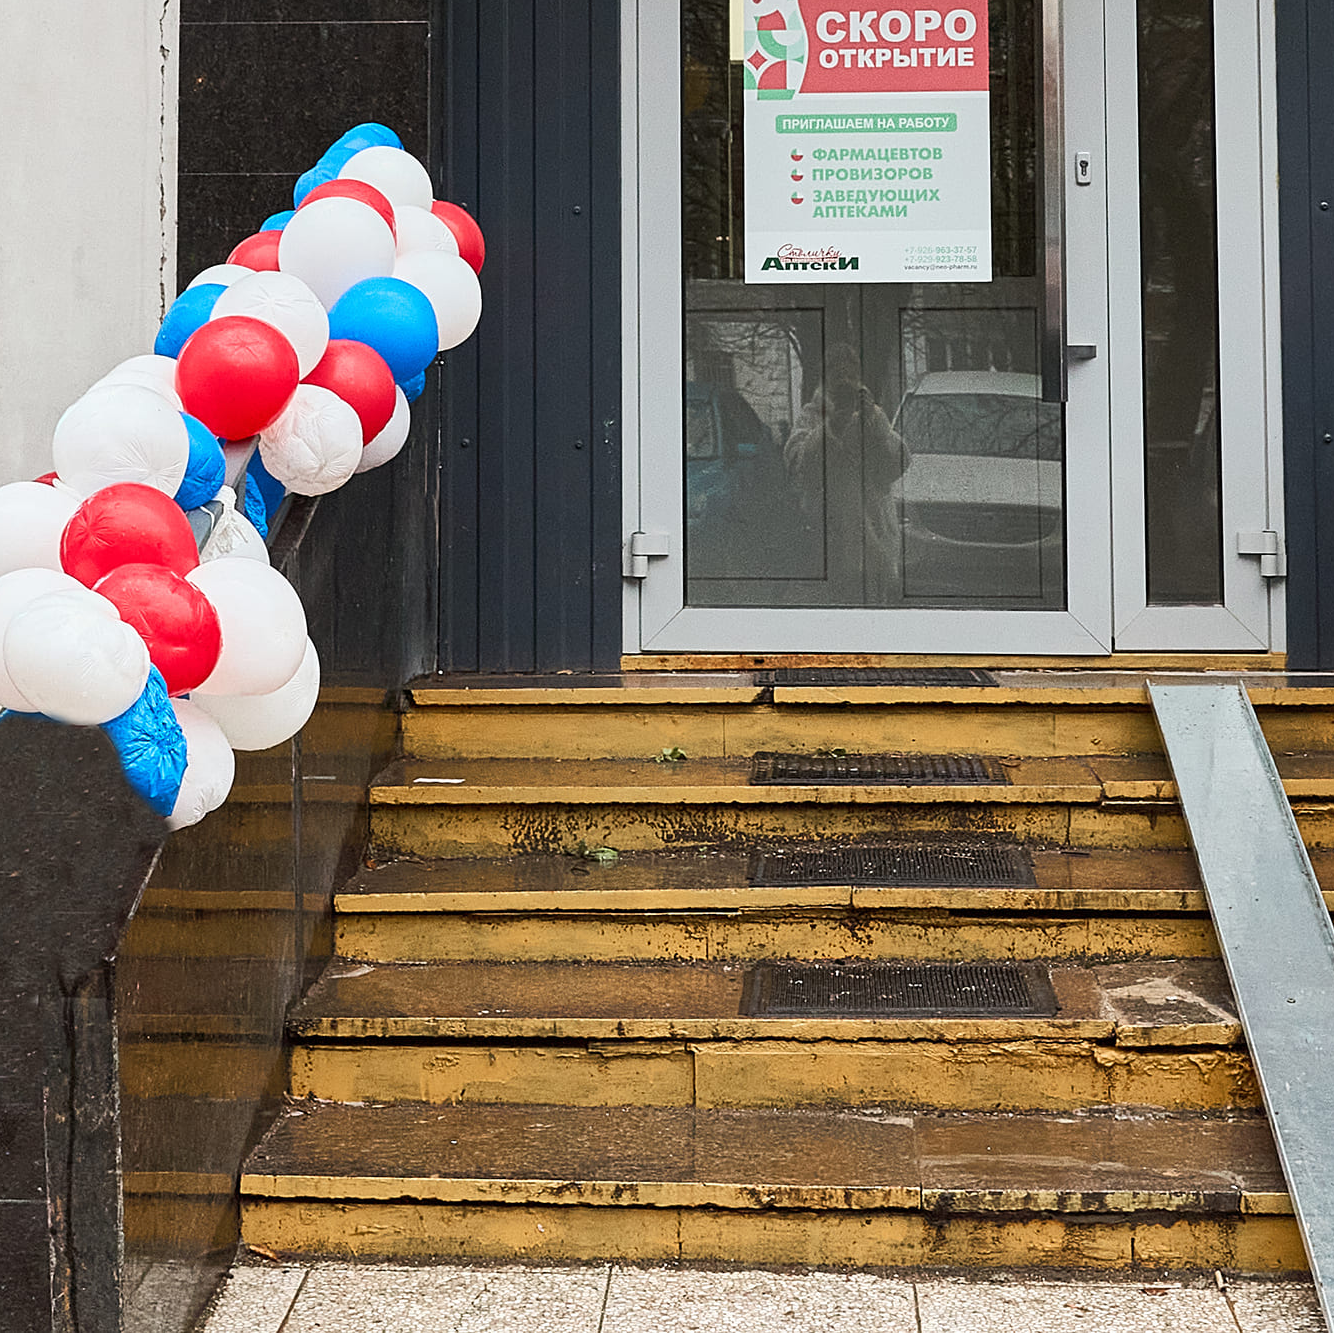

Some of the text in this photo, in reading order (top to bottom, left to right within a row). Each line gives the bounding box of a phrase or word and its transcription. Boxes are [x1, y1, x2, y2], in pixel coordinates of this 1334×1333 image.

[816, 9, 977, 43] СКОРО
[818, 47, 975, 68] ОТКРЫТИЕ
[782, 117, 950, 130] ПРИГЛАШАЕМ НА РАБОТУ
[812, 147, 943, 161] ФАРМАЦЕВТОВ
[812, 167, 933, 181] ПРОВИЗОРОВ
[812, 189, 941, 204] ЗАВЕДУЮЩИХ
[812, 205, 908, 218] АПТЕКАМИ
[777, 243, 843, 259] Столички
